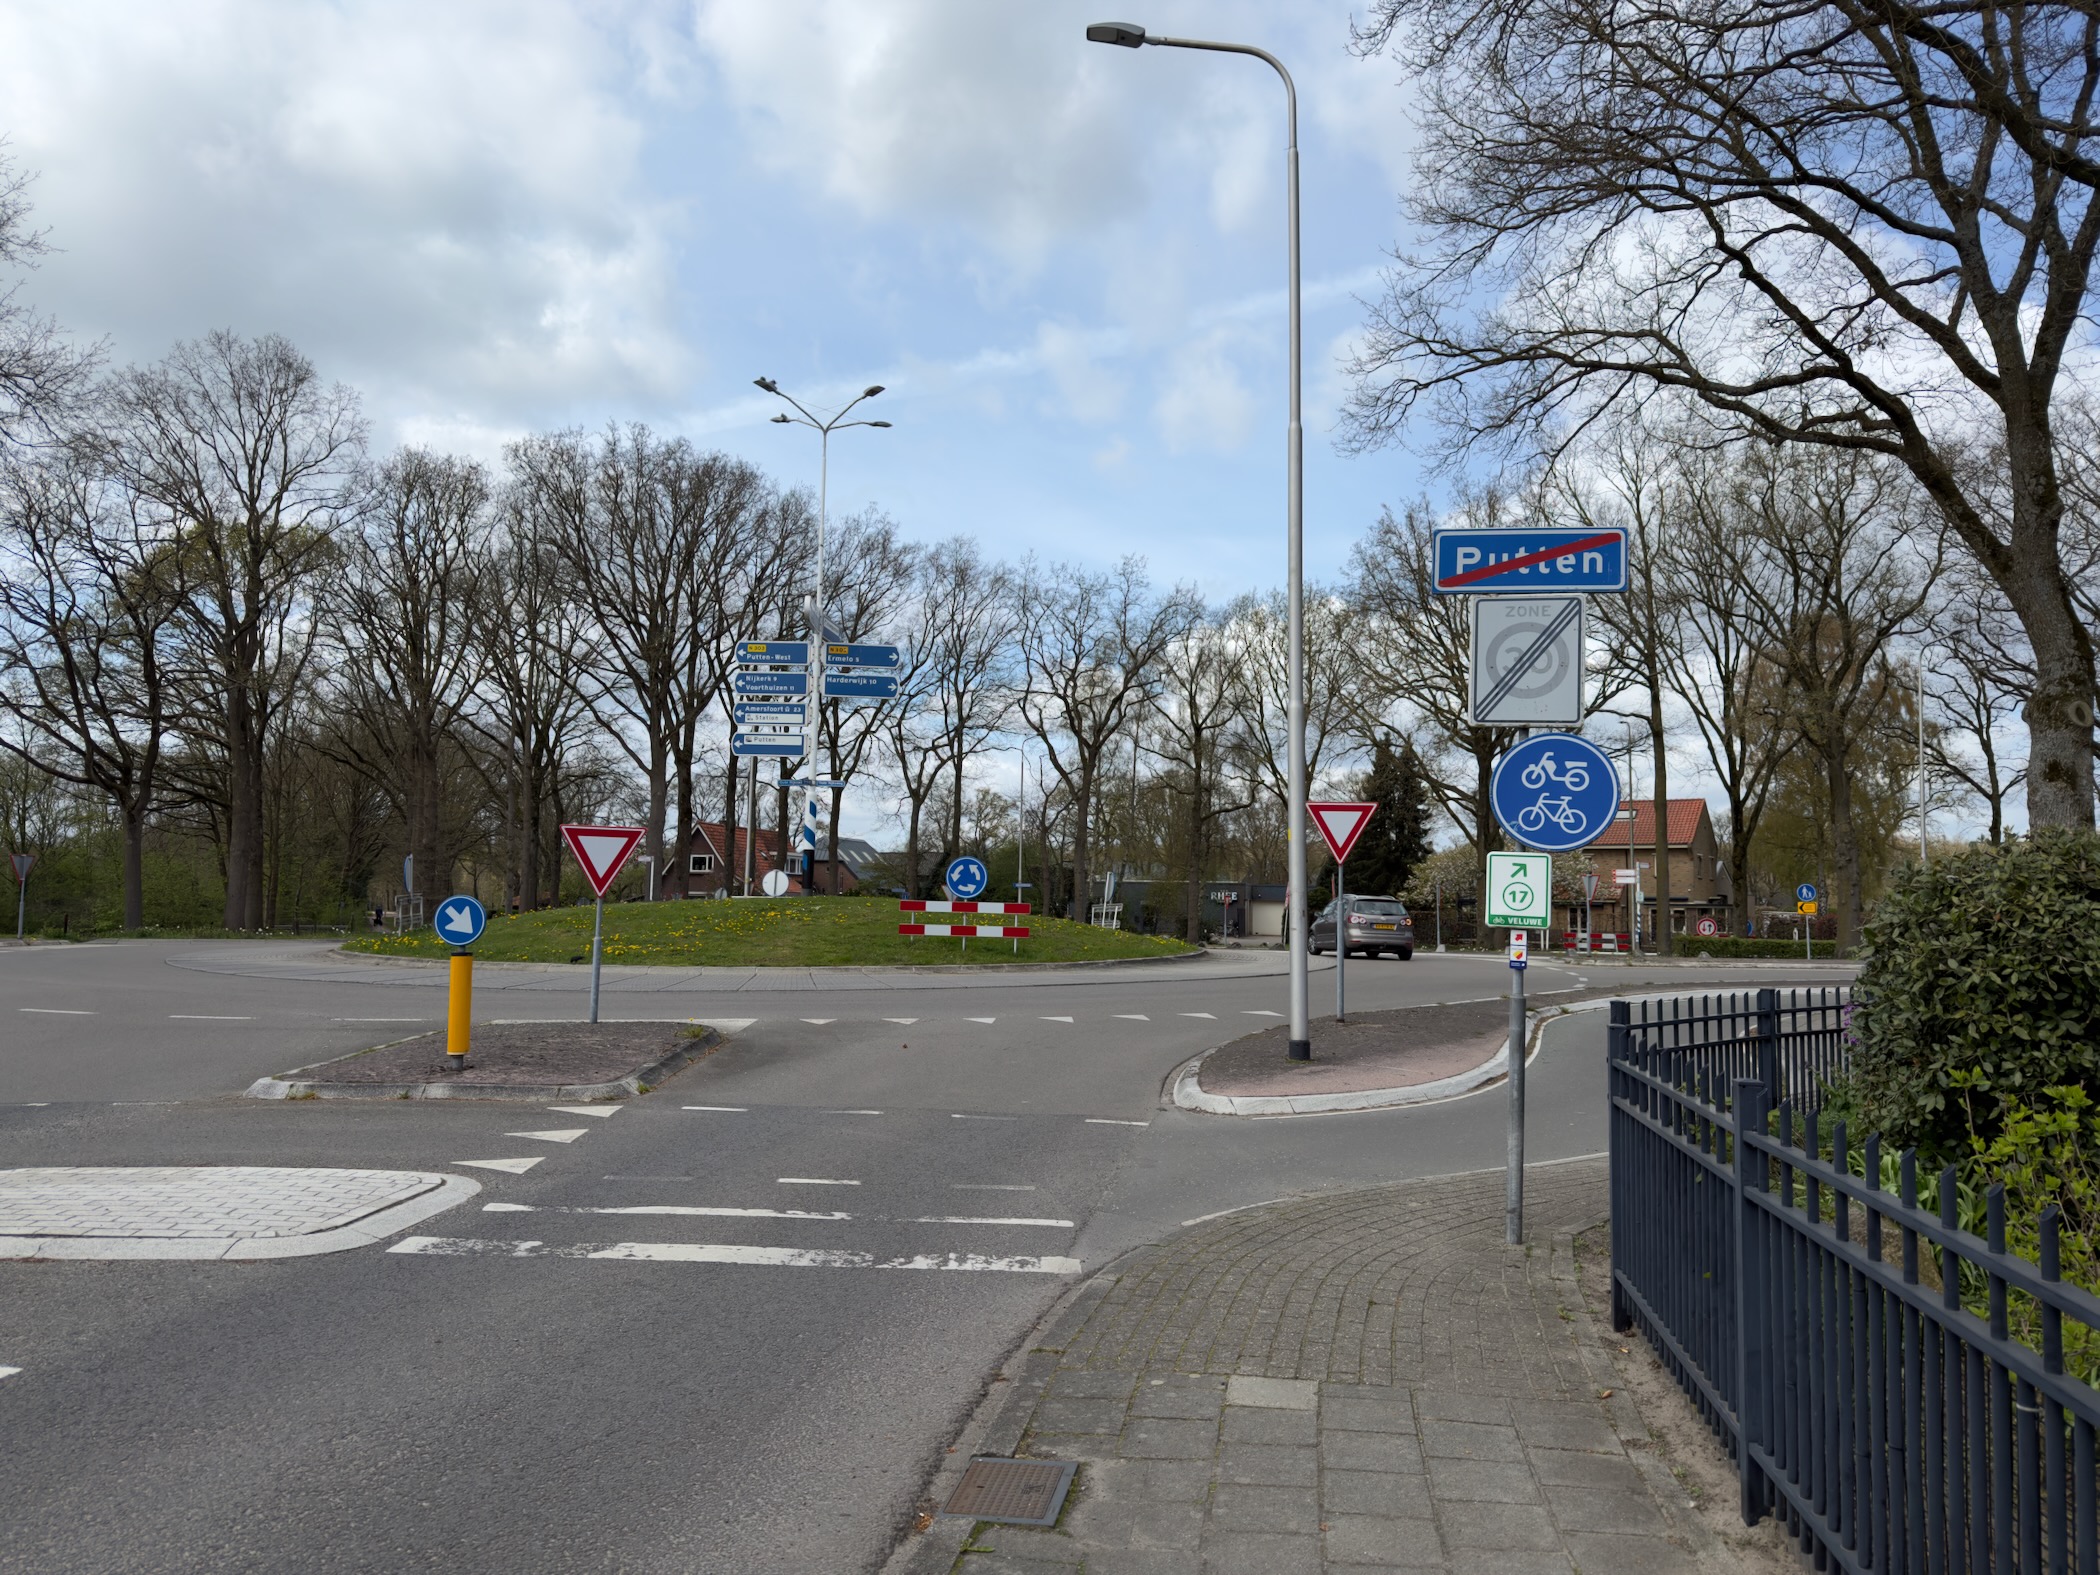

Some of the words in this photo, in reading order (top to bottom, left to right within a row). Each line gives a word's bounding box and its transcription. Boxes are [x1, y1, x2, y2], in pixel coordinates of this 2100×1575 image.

[1456, 546, 1603, 574] Putten
[1505, 605, 1552, 617] ZONE
[1503, 646, 1552, 674] 30
[746, 675, 771, 683] Nijkerk
[827, 677, 867, 685] Harderwijk
[1508, 890, 1529, 904] 17
[1507, 917, 1543, 926] VELUWE
